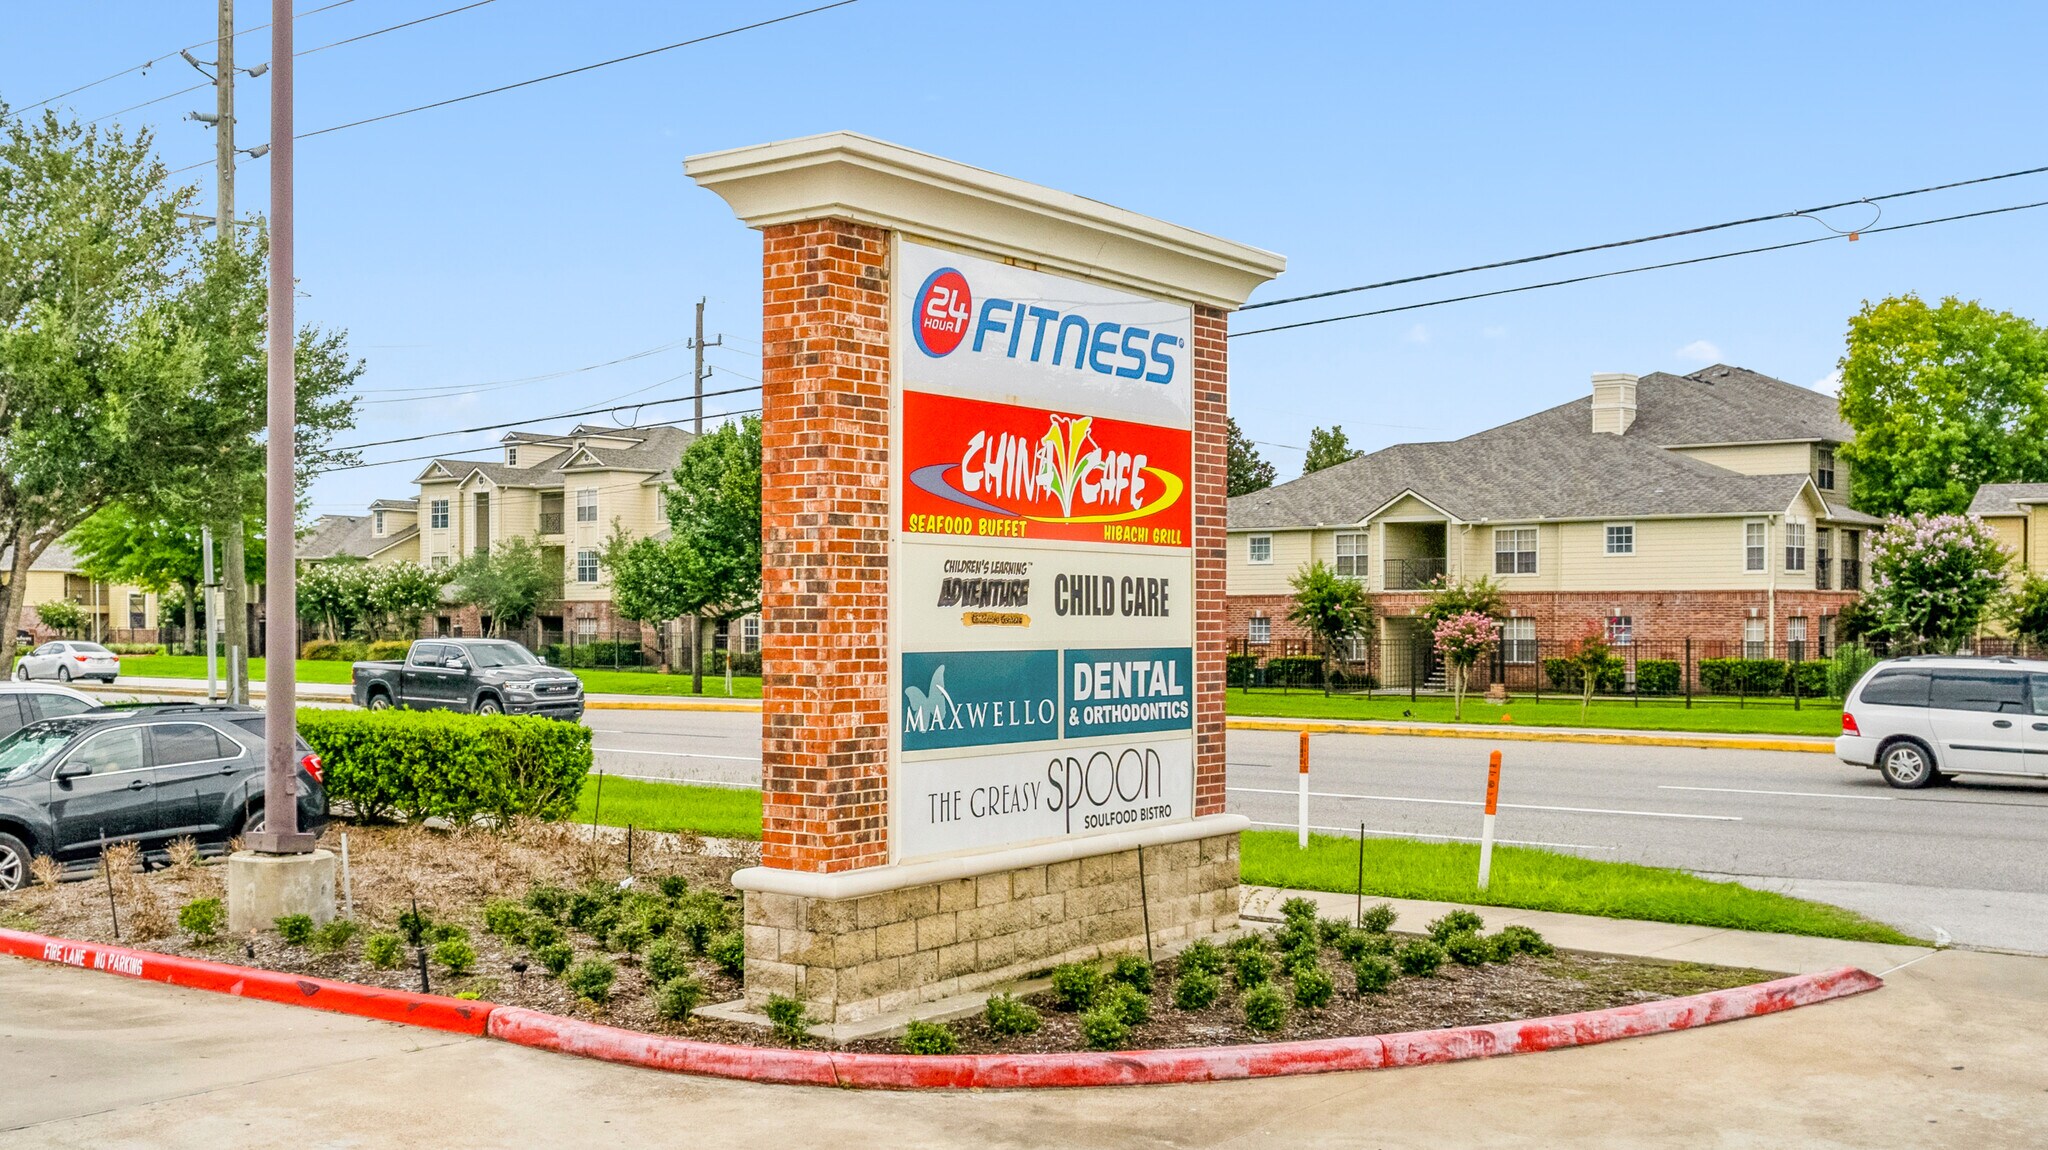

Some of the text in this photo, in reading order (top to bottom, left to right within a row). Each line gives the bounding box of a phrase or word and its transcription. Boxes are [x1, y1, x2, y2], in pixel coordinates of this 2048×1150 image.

[924, 317, 954, 332] HOUR
[926, 285, 969, 334] 24
[961, 430, 1147, 510] CHINA CAFE
[909, 513, 1027, 538] SEAFOOD BUFFET
[1104, 524, 1182, 545] HIBACHI GRILL
[944, 559, 1027, 575] CHILDREN'S LEARNING
[937, 577, 1030, 608] ADVENTURE
[1054, 573, 1169, 617] CHILD CARE
[1073, 660, 1184, 701] DENTAL
[904, 684, 1055, 733] MAXWELLO
[1069, 701, 1189, 726] & ORTHODONTICS
[928, 790, 961, 824] THE
[970, 781, 1041, 818] GREASY
[1084, 804, 1172, 829] SOULFOOD BISTRO
[43, 942, 143, 975] FIRE LANE NO PARKING
